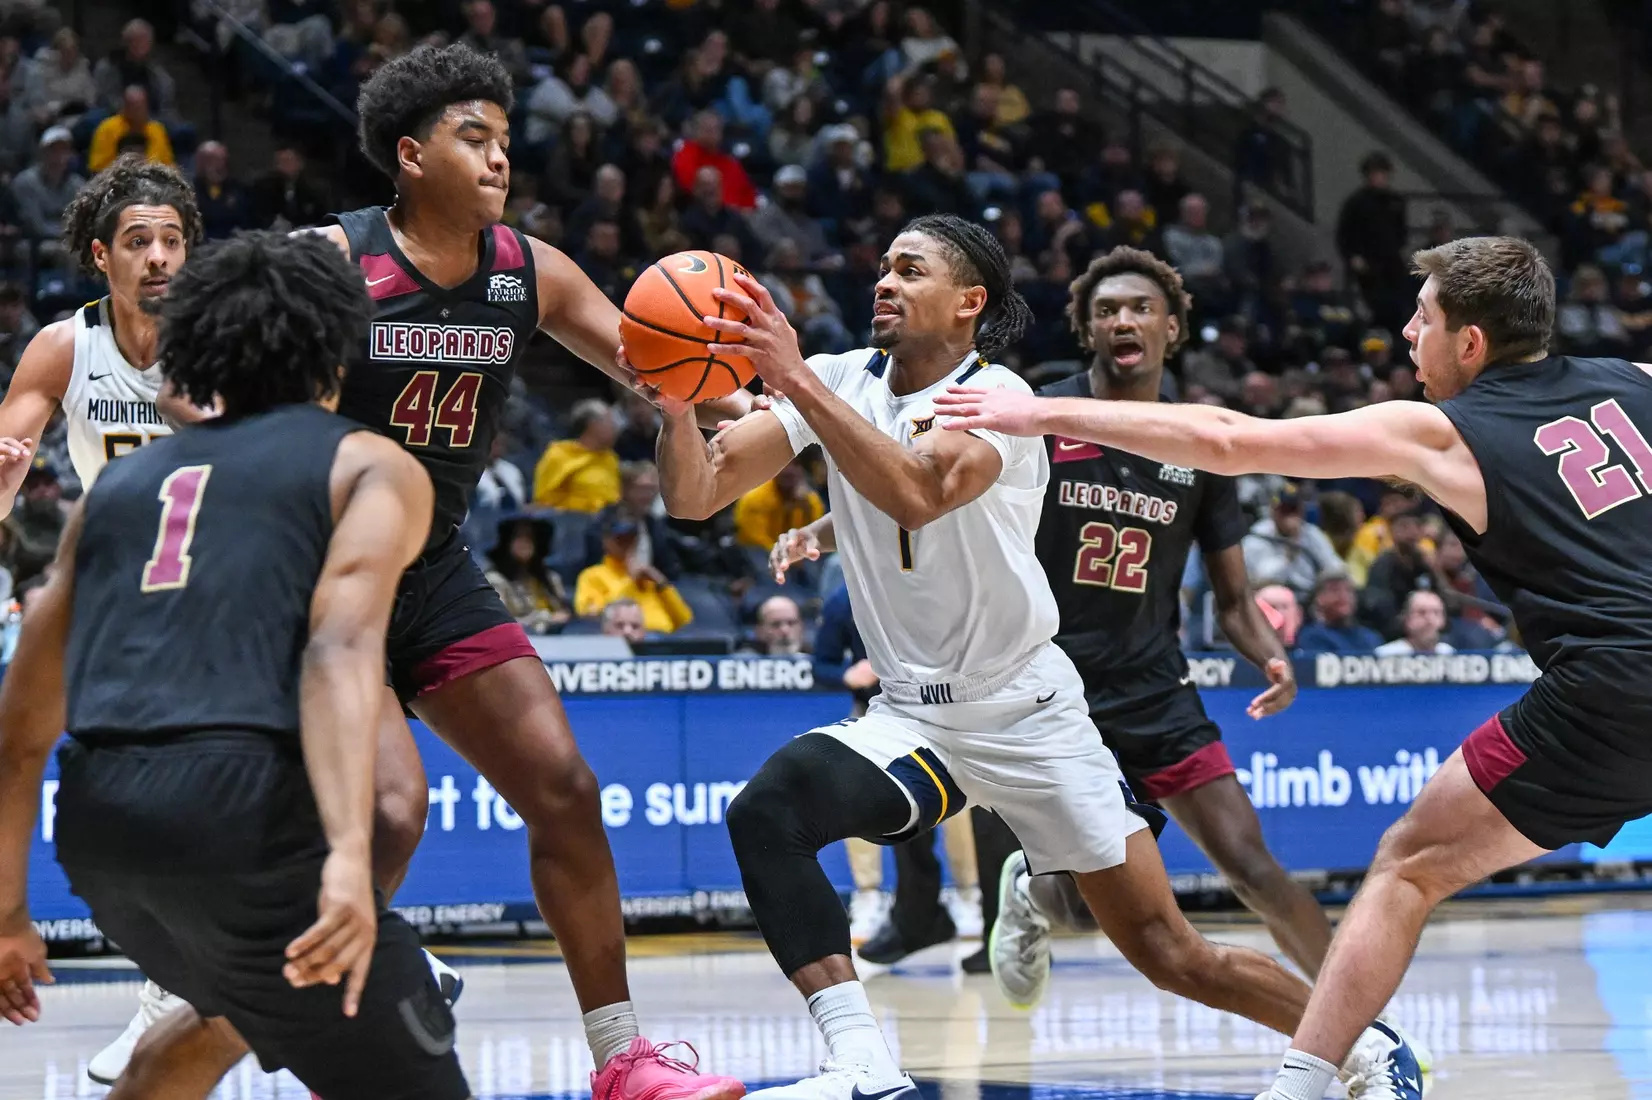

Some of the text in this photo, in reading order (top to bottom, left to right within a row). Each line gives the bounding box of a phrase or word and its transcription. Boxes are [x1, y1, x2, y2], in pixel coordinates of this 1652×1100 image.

[487, 287, 527, 296] PATRIOT
[487, 294, 527, 302] LEAGUE
[370, 322, 514, 364] LEOPARDS
[389, 370, 484, 447] 44
[1533, 398, 1652, 520] 21
[1059, 481, 1178, 525] LEOPARDS
[140, 464, 213, 593] 1
[1073, 521, 1152, 593] 22
[544, 660, 713, 692] IVERSIFIED
[1341, 654, 1490, 684] DIVERSIFIED
